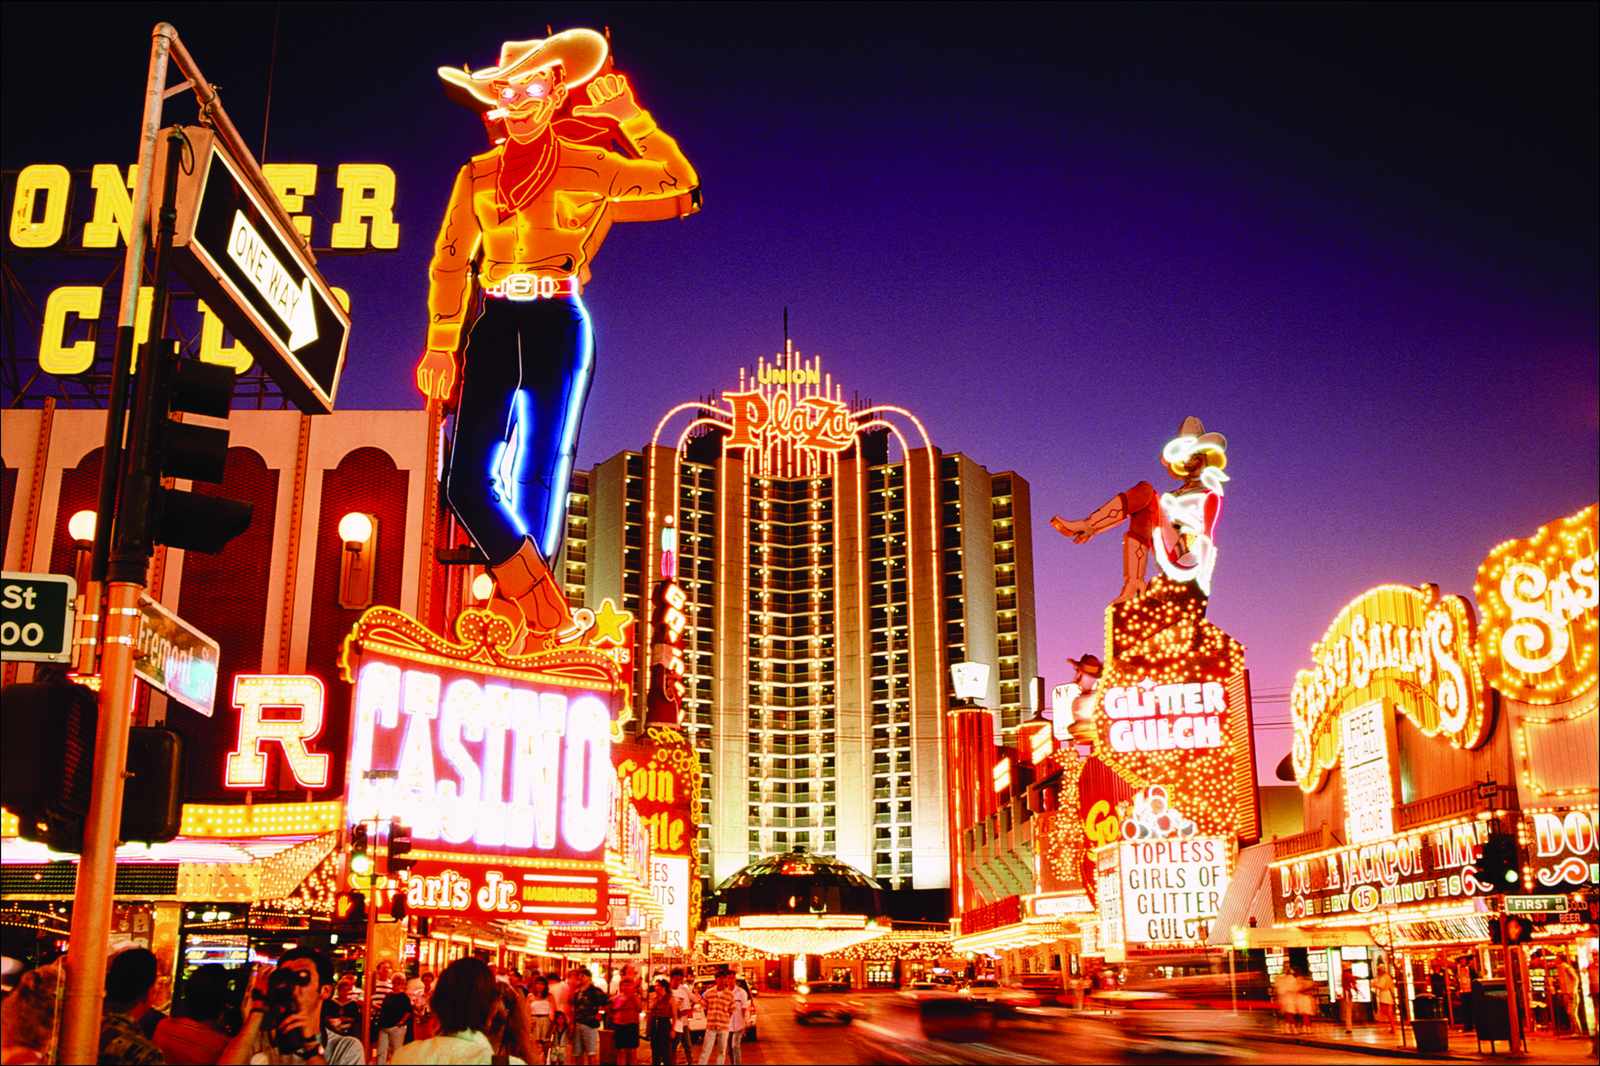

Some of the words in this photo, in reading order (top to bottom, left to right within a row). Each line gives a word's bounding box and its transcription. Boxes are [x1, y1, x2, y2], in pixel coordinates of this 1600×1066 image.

[10, 163, 399, 249] ONER
[236, 226, 267, 283] ONE
[268, 264, 300, 321] WAY
[757, 368, 820, 385] UNION
[722, 389, 858, 452] Plaza
[3, 585, 37, 610] St
[137, 613, 193, 685] Fremont
[226, 675, 328, 788] R
[1110, 715, 1222, 752] GULCH
[348, 661, 611, 852] CASINO
[1130, 841, 1215, 864] TOPLESS
[1281, 853, 1341, 897] DOUE
[1341, 832, 1424, 894] JACKPOT
[477, 870, 520, 913] Jr.
[523, 886, 598, 903] HAMBURGERS
[1129, 868, 1187, 890] GIRLS
[1199, 866, 1221, 888] OF
[1305, 893, 1350, 916] EVERY
[1381, 875, 1462, 905] MINUTES
[1137, 891, 1220, 915] GLITTER
[1515, 899, 1548, 909] FIRST
[1560, 913, 1580, 923] BEER
